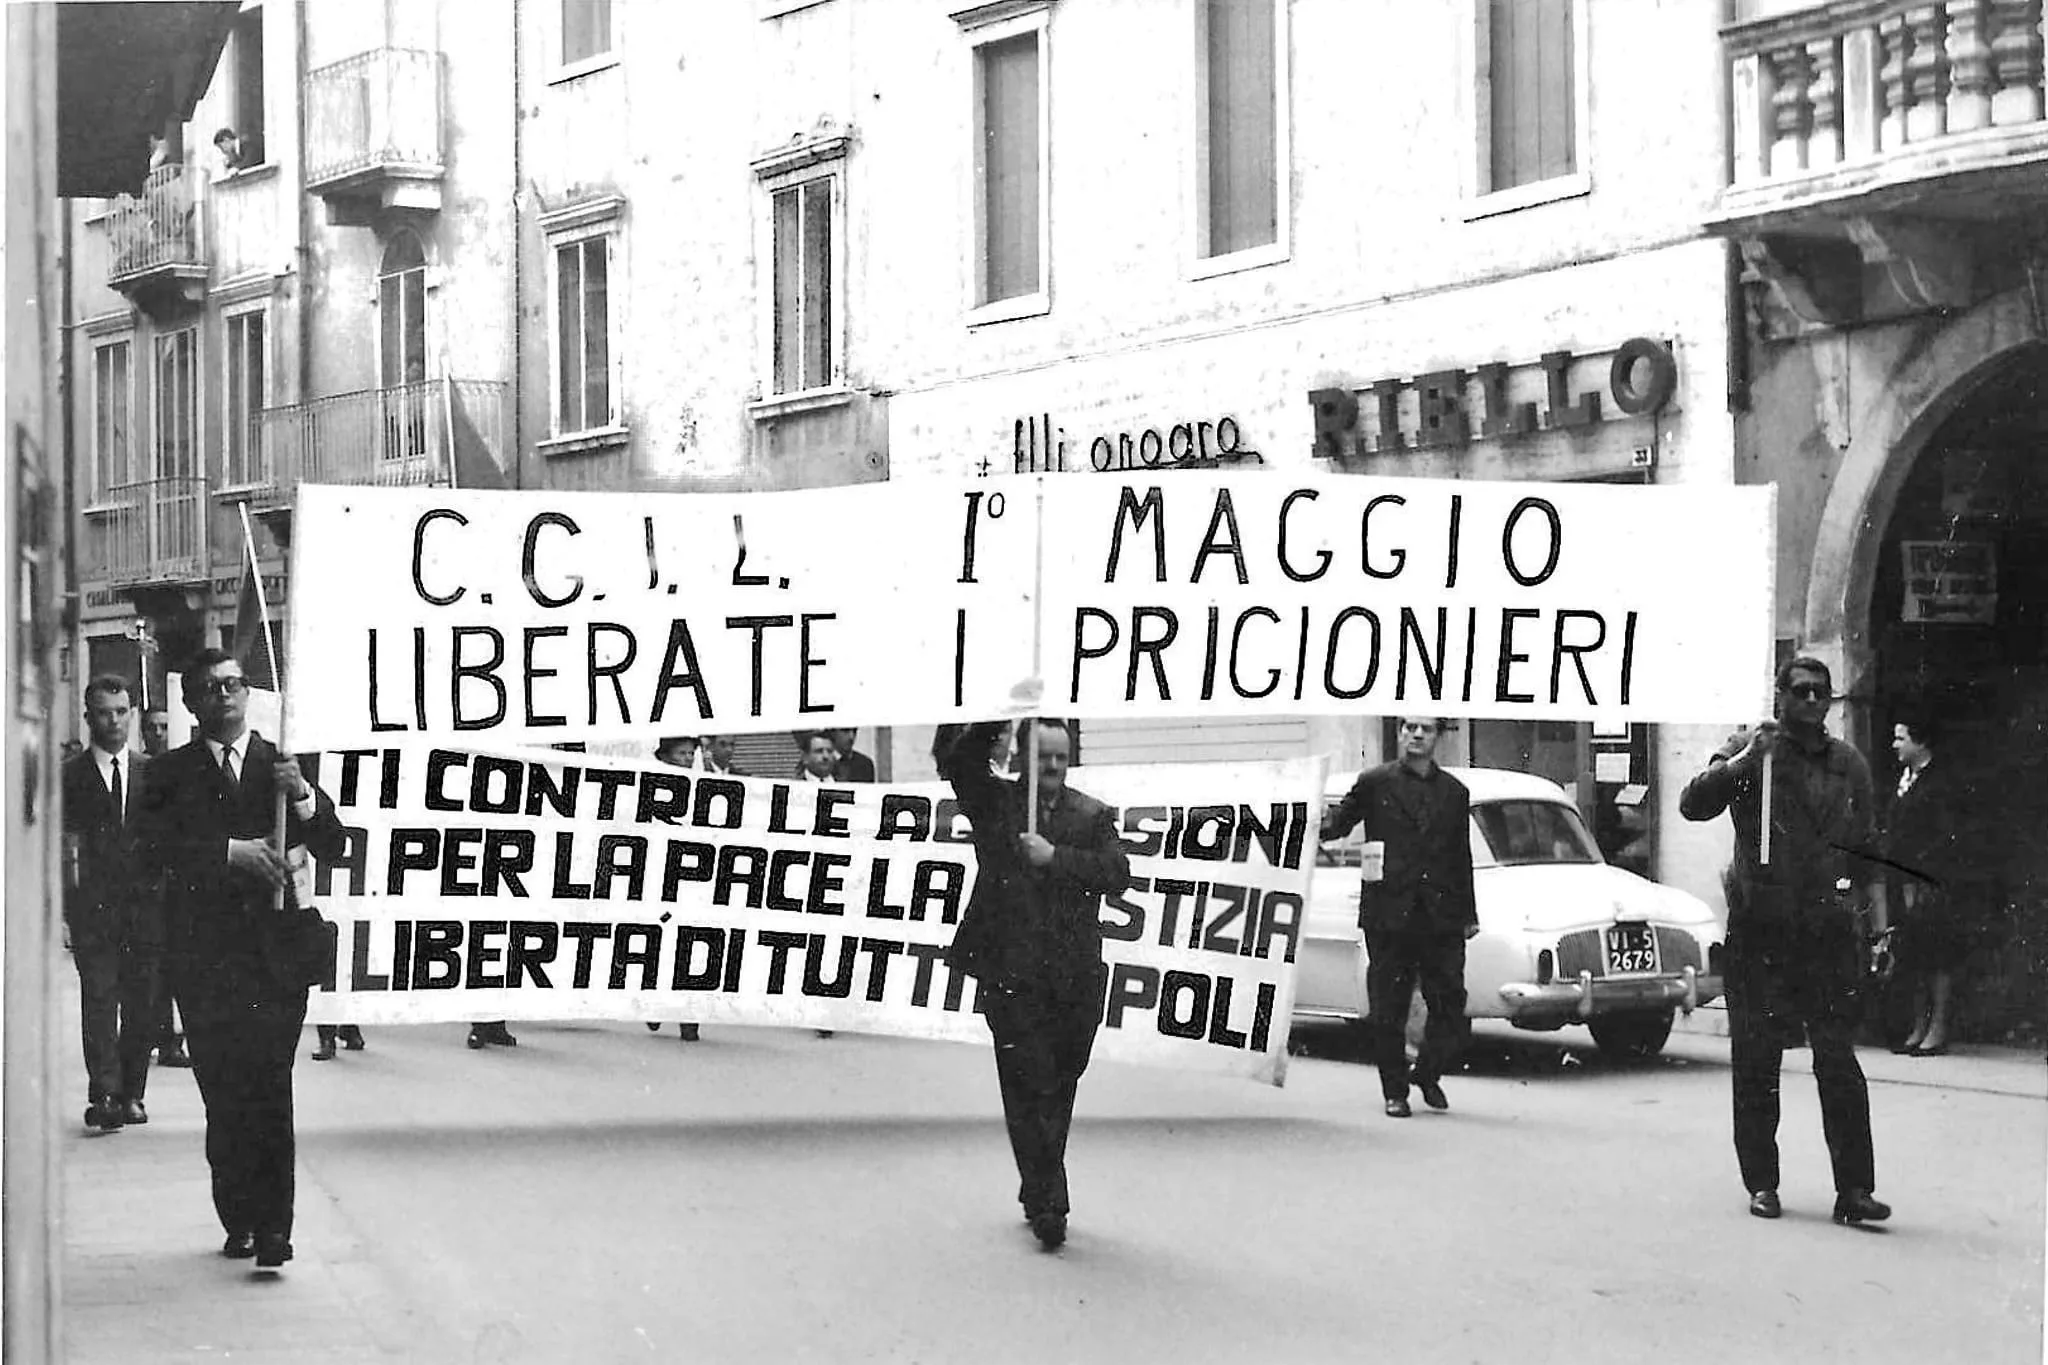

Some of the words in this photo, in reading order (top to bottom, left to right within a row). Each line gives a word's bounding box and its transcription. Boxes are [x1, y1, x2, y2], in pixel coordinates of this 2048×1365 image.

[1104, 486, 1562, 588] MAGGIO
[368, 613, 836, 732] LIBERATE
[954, 608, 966, 706] I
[1070, 605, 1638, 706] PRIGIONIERI
[424, 749, 745, 829] CONTRO
[767, 784, 856, 838] LE
[387, 828, 536, 898] PER
[552, 831, 648, 900] LA
[661, 839, 852, 916] PACE
[866, 858, 966, 925] LA
[671, 925, 746, 994] DI
[1611, 951, 1654, 970] 2679
